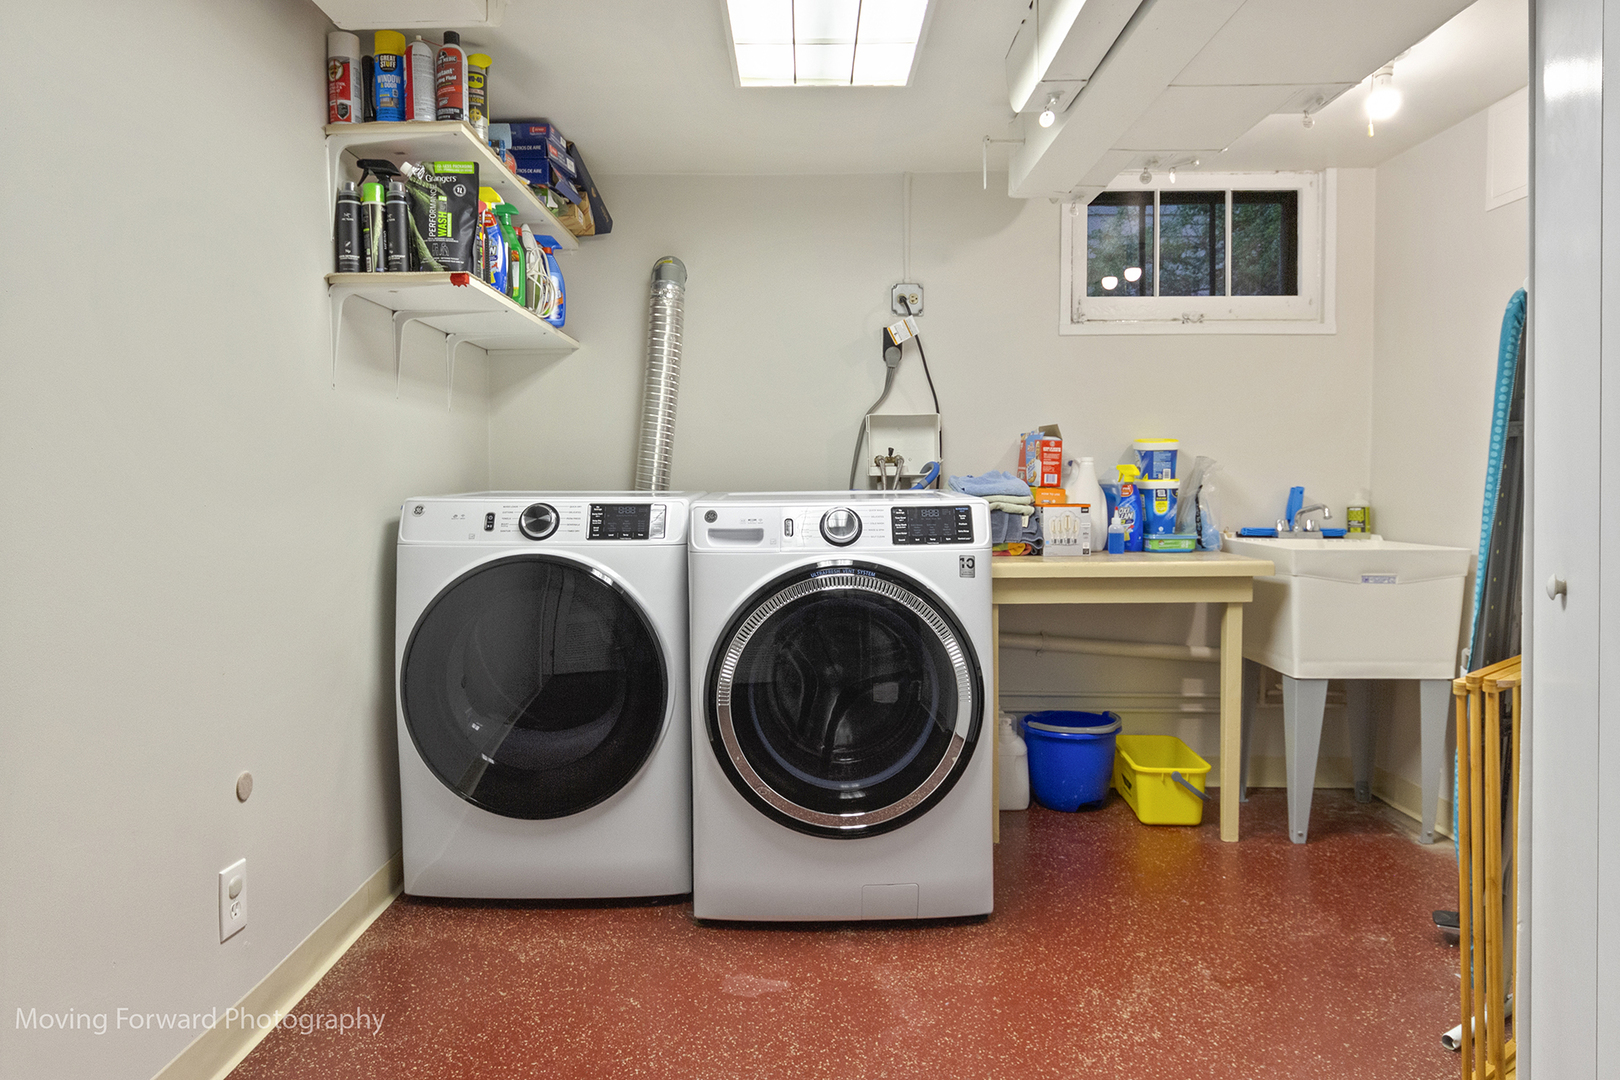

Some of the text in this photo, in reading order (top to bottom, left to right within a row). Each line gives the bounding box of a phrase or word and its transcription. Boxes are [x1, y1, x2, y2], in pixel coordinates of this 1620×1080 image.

[377, 74, 401, 84] WINDOW
[426, 174, 457, 183] Grangers
[428, 184, 437, 237] PERFORMANCE
[438, 211, 447, 237] WASH
[810, 568, 840, 578] ULTRAFRESH
